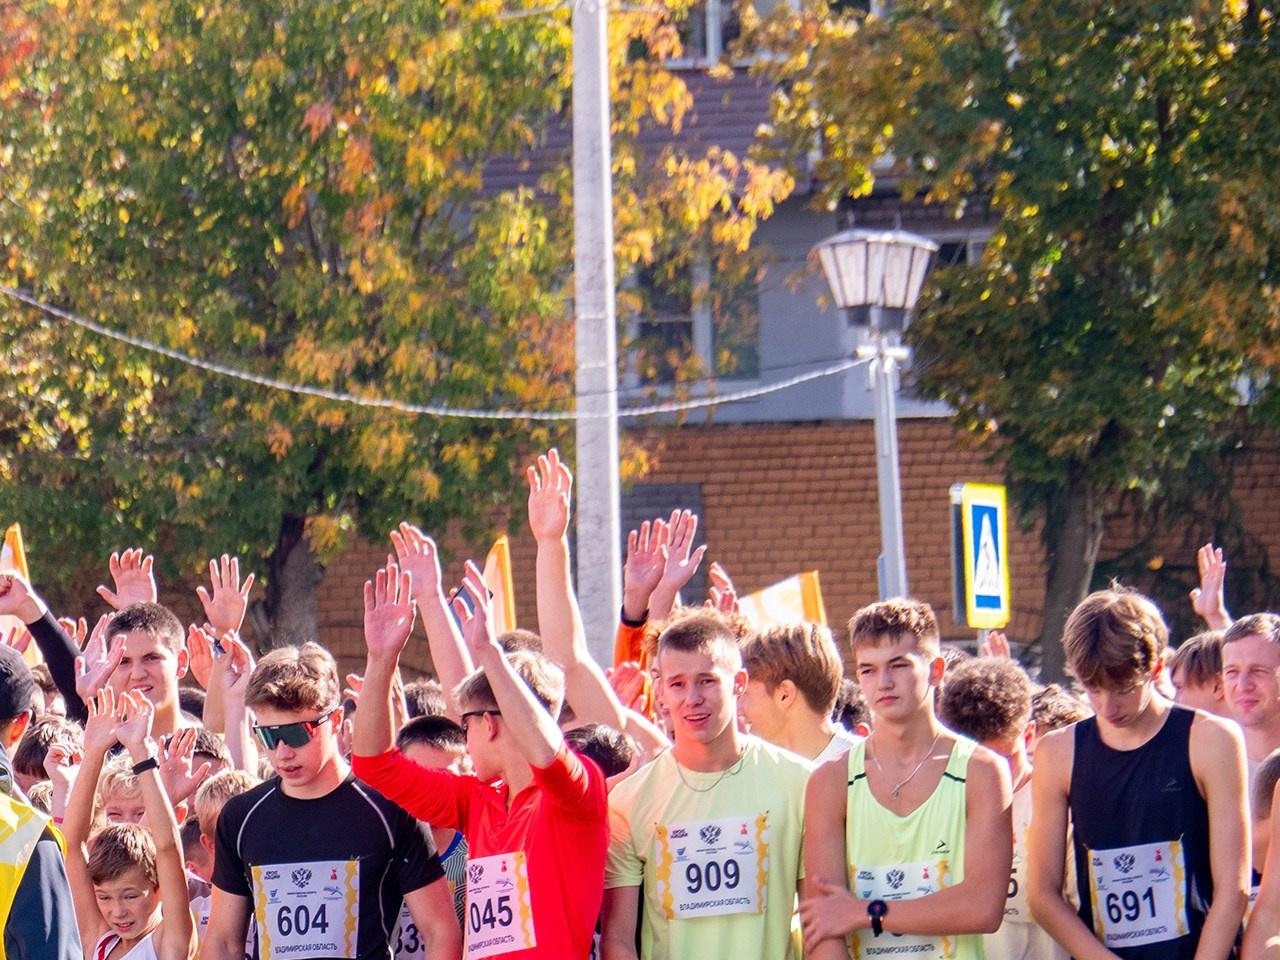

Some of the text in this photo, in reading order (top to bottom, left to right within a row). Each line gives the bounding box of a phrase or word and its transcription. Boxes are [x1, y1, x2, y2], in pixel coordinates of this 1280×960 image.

[685, 859, 740, 894] 909
[277, 904, 329, 936] 604
[468, 895, 513, 935] 045
[1106, 886, 1156, 923] 691
